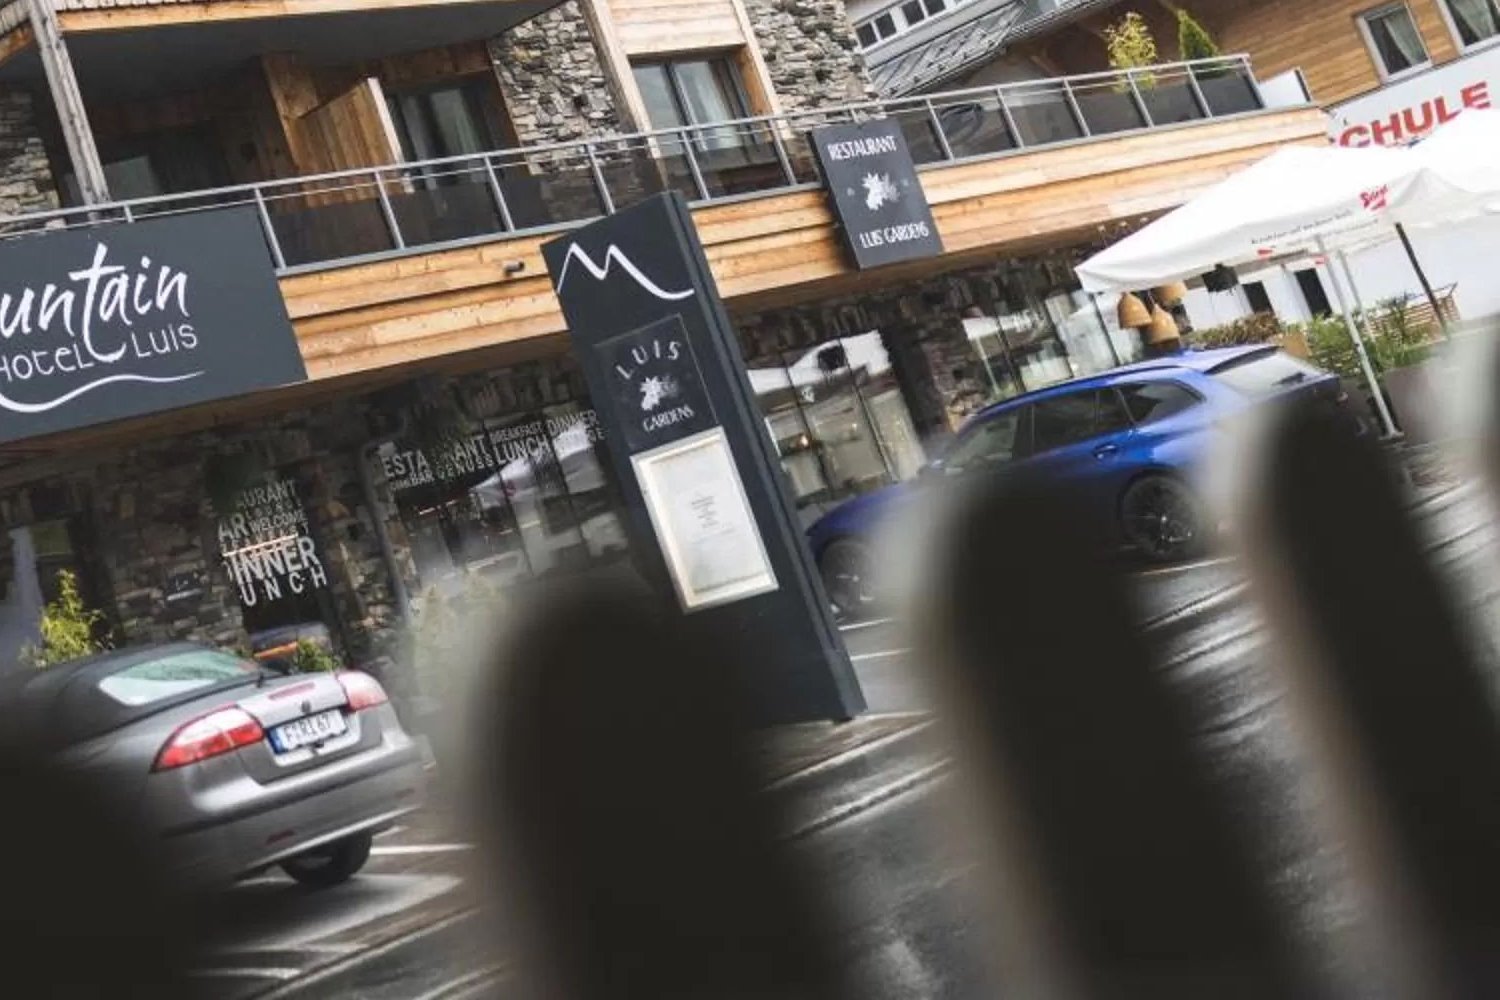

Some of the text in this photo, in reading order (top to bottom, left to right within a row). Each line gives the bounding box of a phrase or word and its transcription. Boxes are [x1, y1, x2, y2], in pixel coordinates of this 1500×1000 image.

[827, 135, 897, 161] RESTAURANT
[859, 221, 930, 249] LUIS GARDENS
[131, 323, 198, 360] LUIS
[615, 339, 681, 380] LUIS
[643, 404, 695, 432] GARDENS
[492, 433, 552, 466] LUNCH
[240, 564, 328, 607] UNCH
